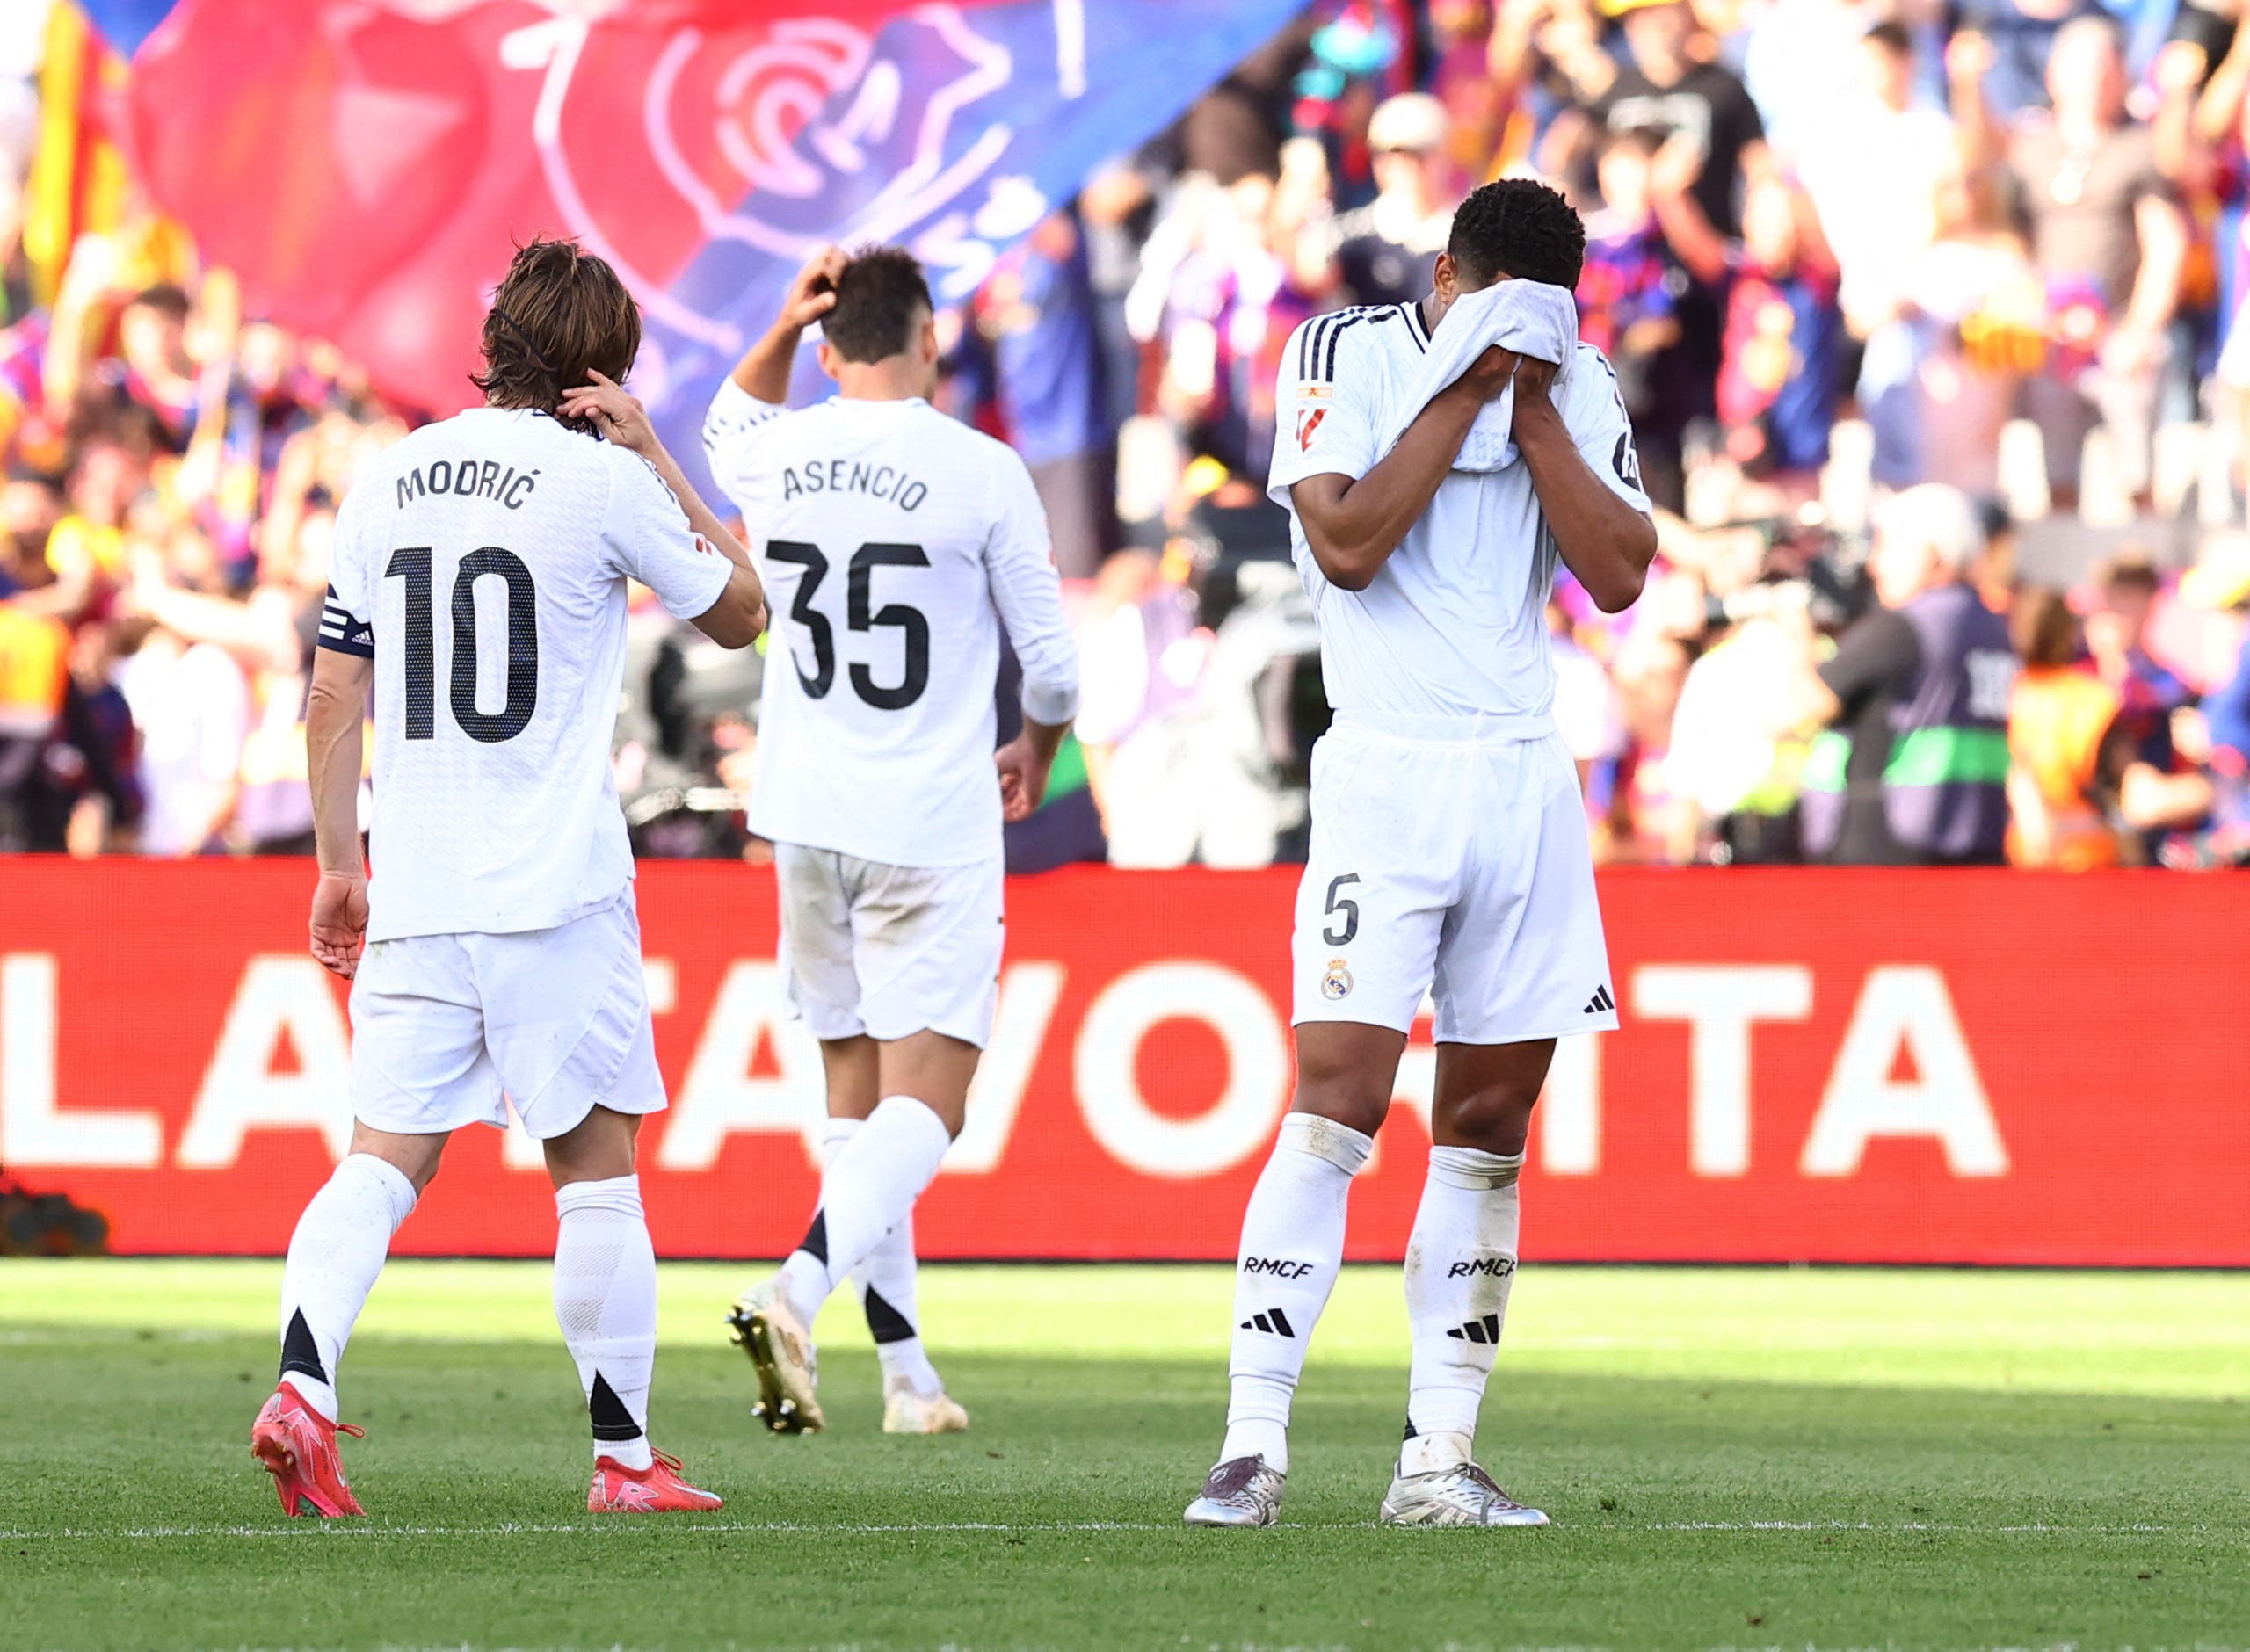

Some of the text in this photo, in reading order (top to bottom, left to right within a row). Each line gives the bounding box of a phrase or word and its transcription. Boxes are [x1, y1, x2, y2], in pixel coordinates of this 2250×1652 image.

[396, 460, 542, 511] MODRIĆ
[783, 459, 929, 512] ASENCIO
[383, 546, 539, 743] 10
[765, 539, 932, 711] 35
[1322, 872, 1361, 946] 5
[0, 952, 359, 1170] LA
[1243, 1256, 1315, 1280] RMCF
